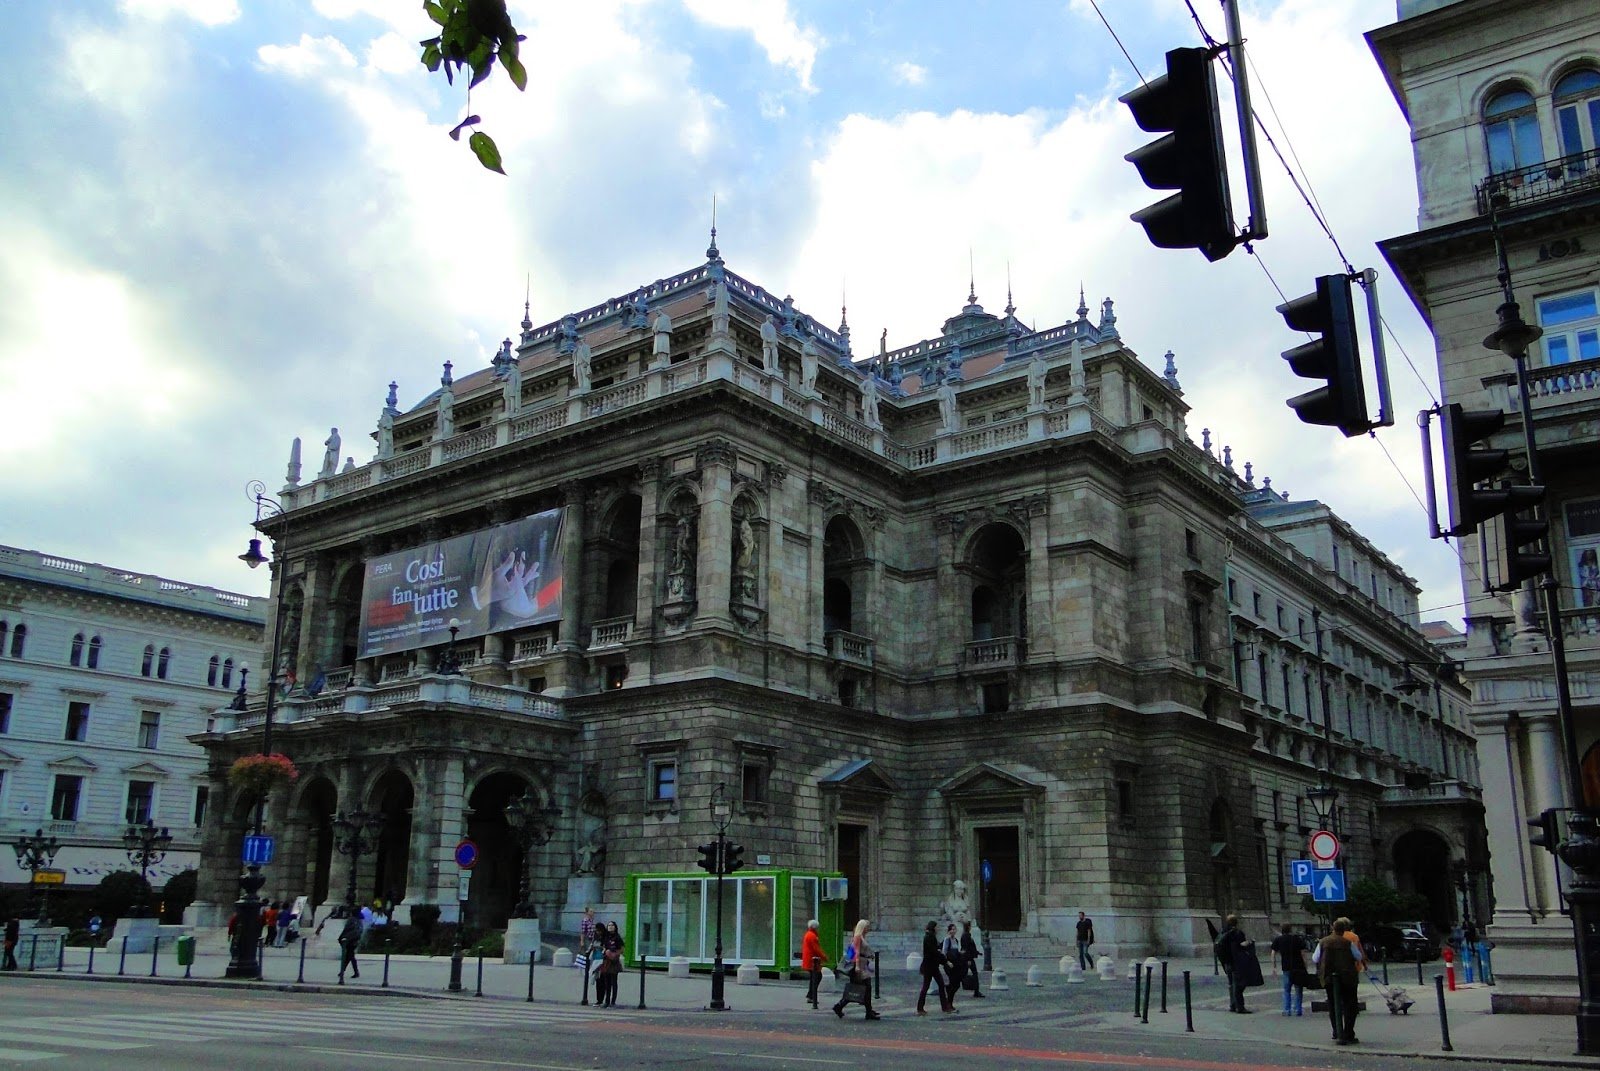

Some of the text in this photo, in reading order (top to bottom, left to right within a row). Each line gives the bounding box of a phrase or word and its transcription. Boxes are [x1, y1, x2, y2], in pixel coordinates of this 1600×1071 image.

[391, 586, 413, 606] fan
[413, 586, 459, 615] tutte
[1297, 863, 1309, 883] P
